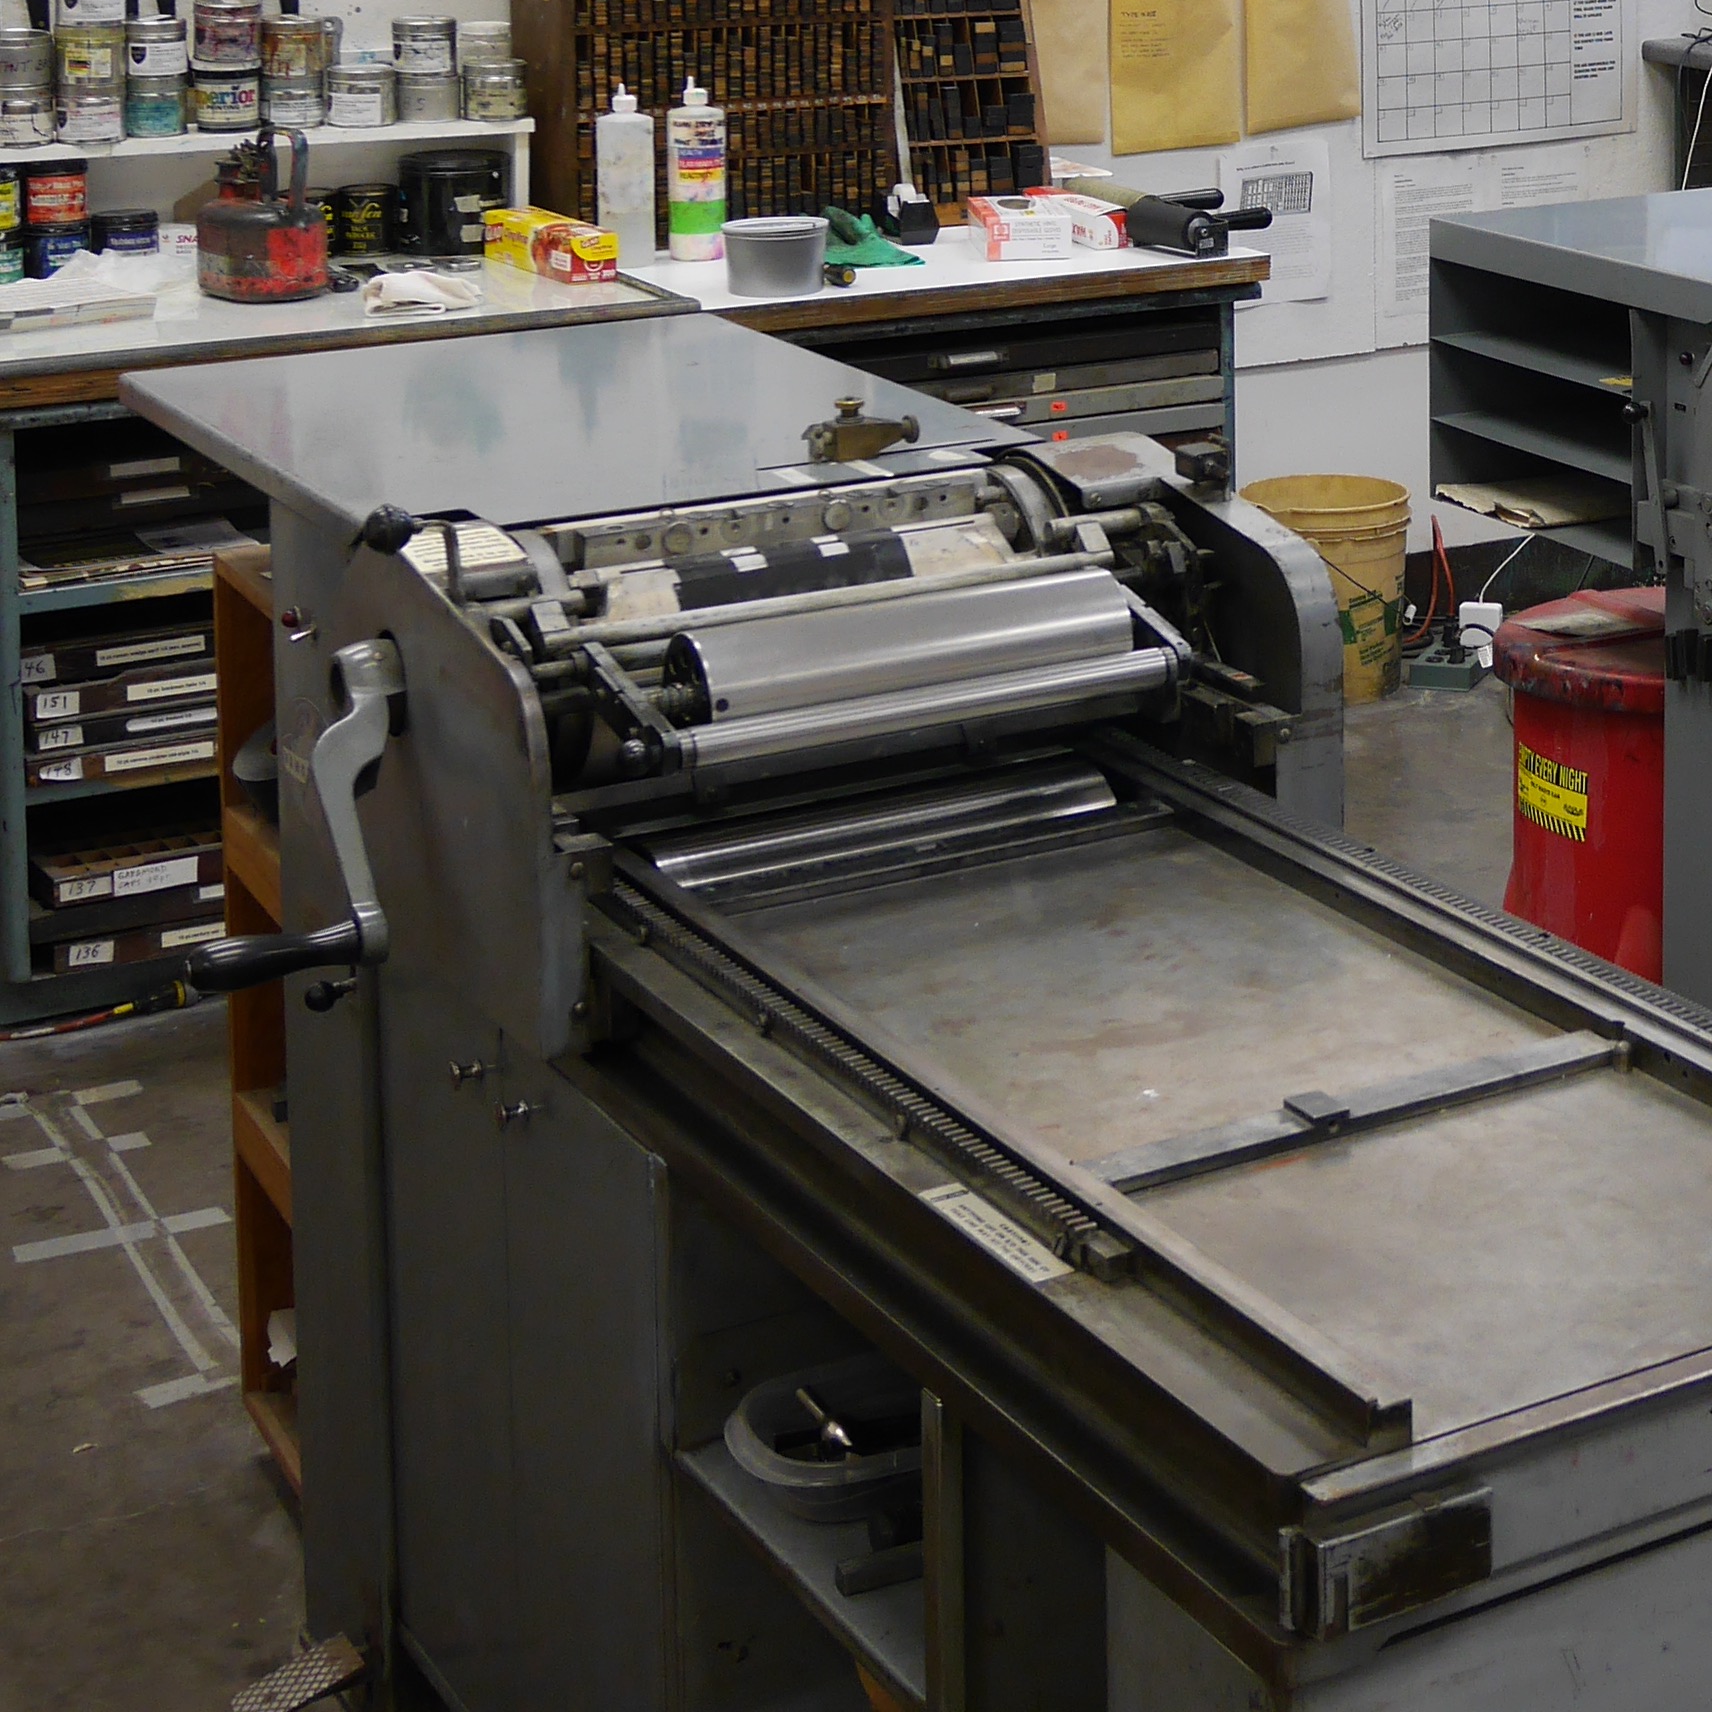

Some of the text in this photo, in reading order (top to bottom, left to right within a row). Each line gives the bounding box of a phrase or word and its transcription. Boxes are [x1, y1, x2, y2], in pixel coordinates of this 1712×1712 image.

[43, 696, 68, 709] 151
[44, 730, 70, 744] 147
[1535, 754, 1558, 784] EVERY
[1559, 765, 1588, 794] NIGHT
[69, 880, 96, 896] 137
[75, 944, 100, 961] 136
